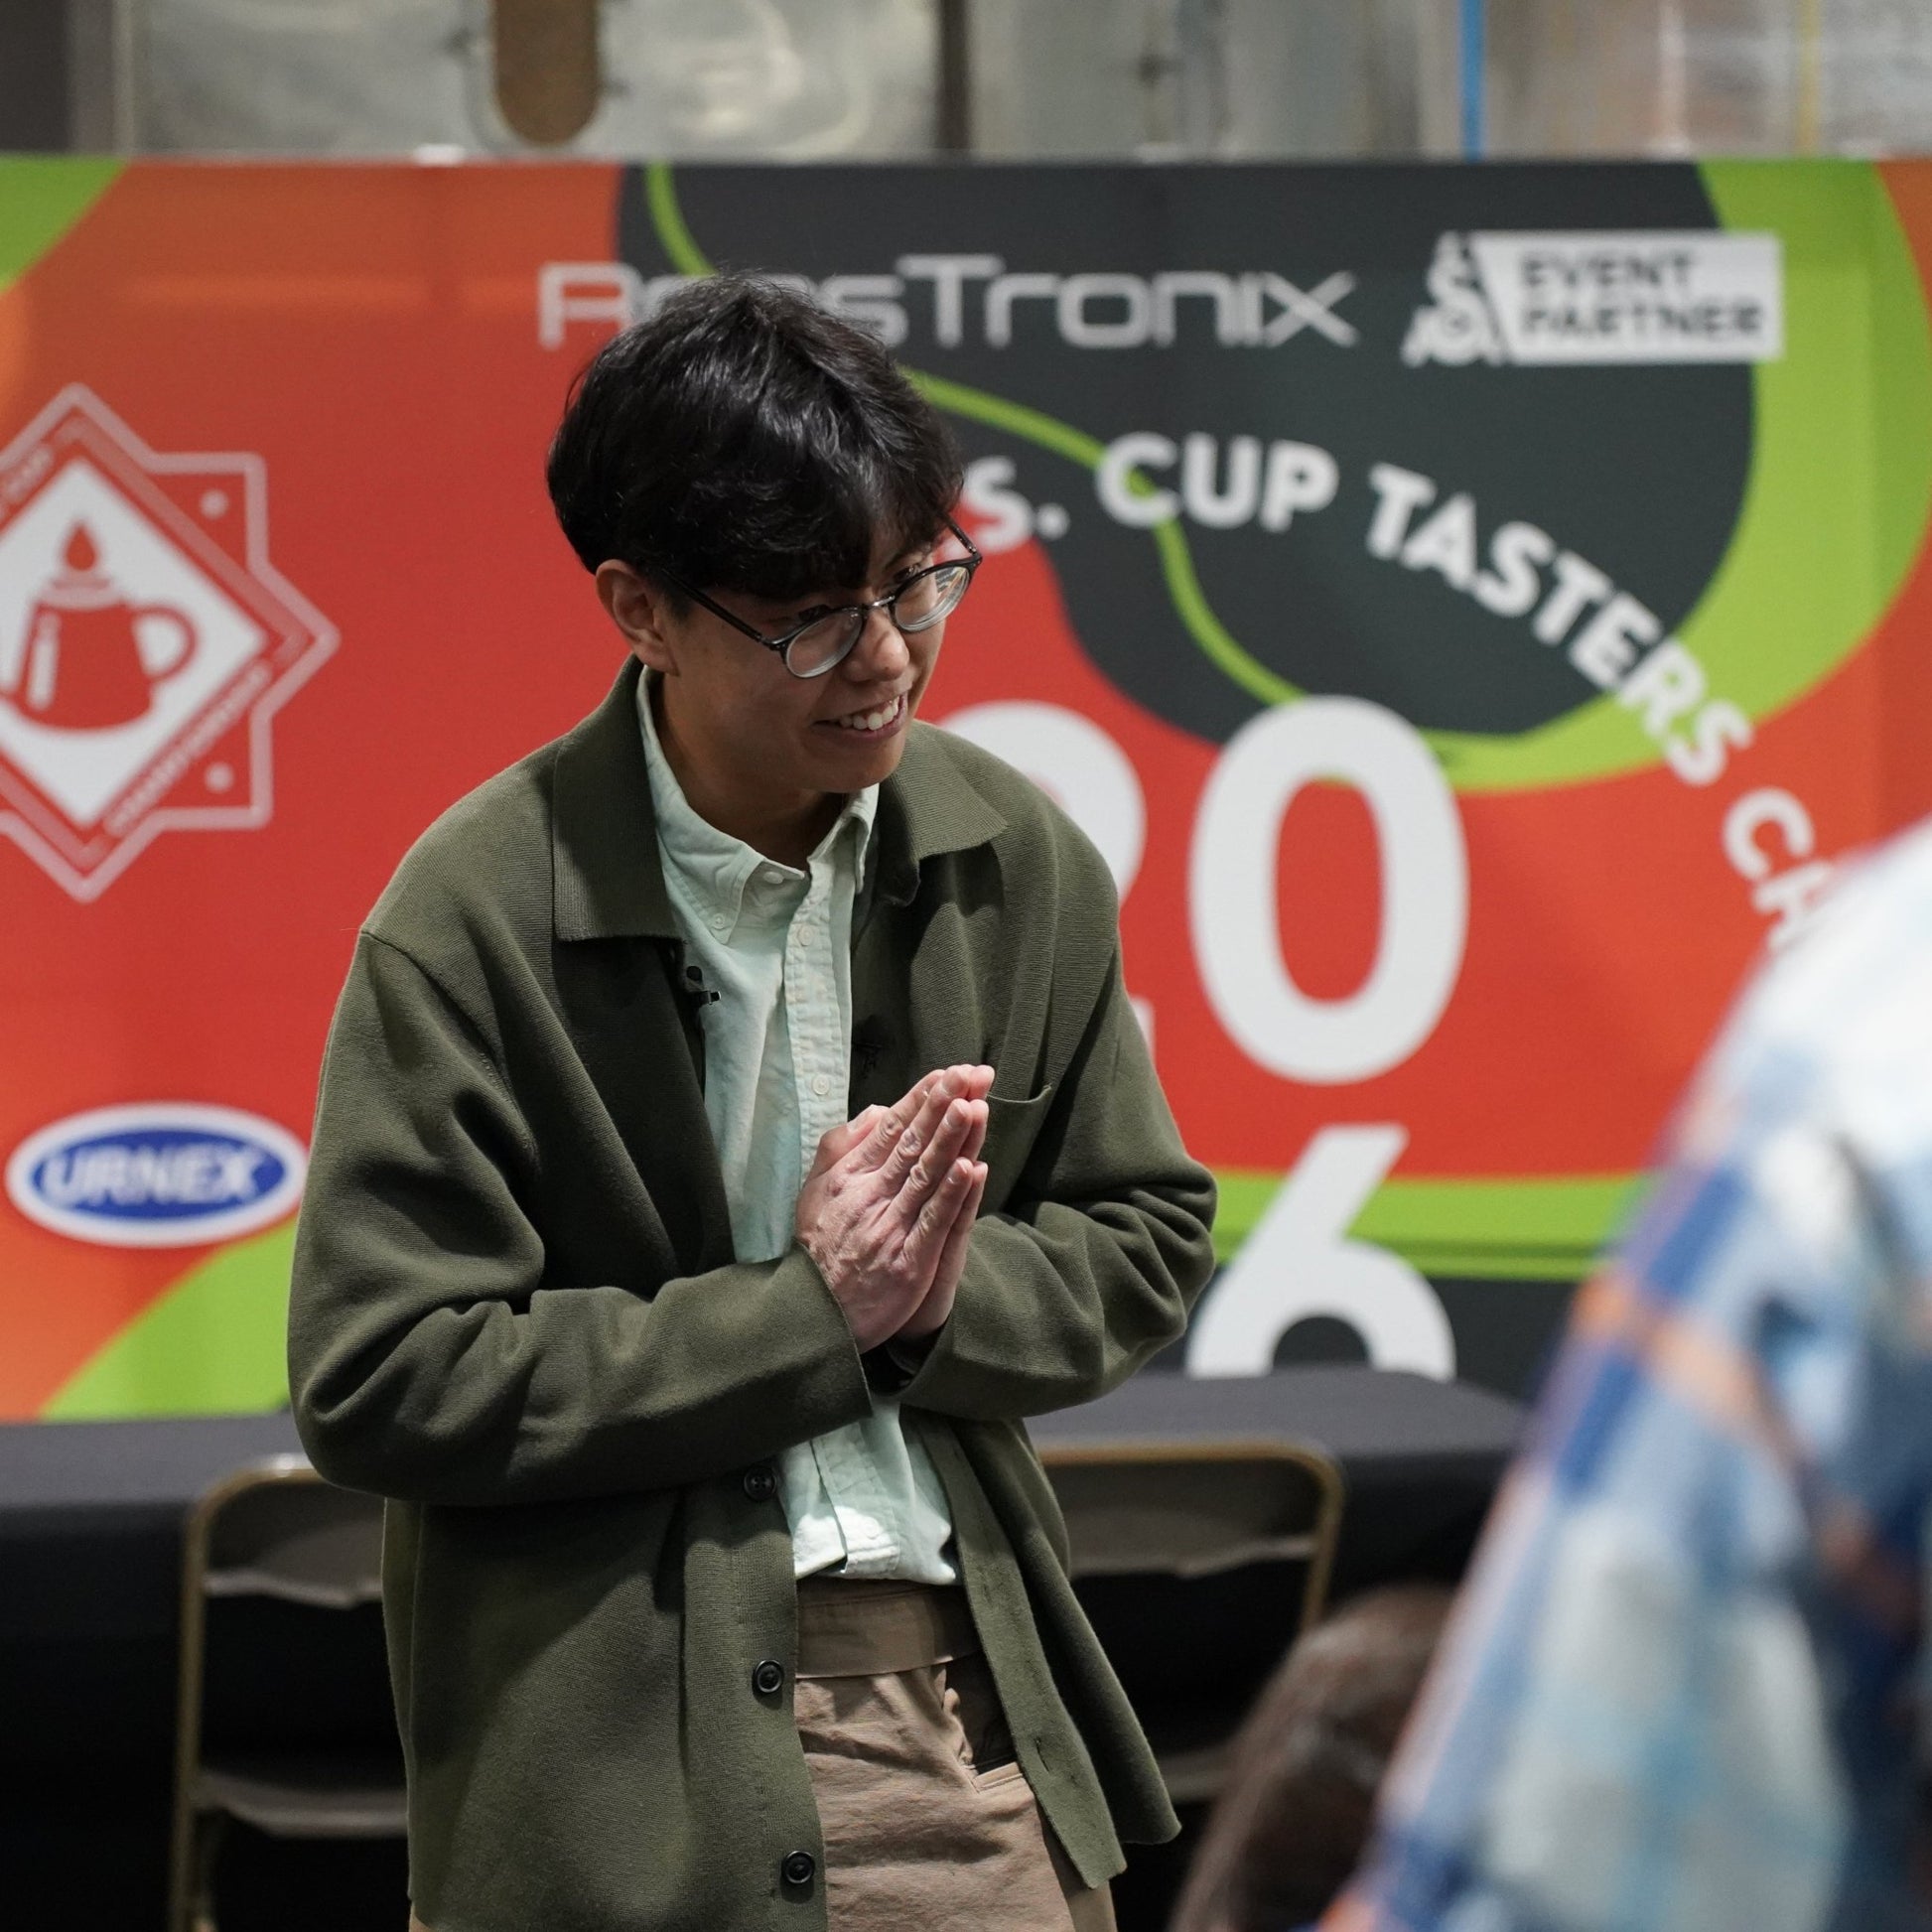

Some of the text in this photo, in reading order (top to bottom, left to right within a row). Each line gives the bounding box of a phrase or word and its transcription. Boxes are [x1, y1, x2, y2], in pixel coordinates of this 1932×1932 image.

[1520, 251, 1696, 291] EVENT
[1098, 433, 1338, 530] CUP
[1367, 463, 1754, 784] TASTERS
